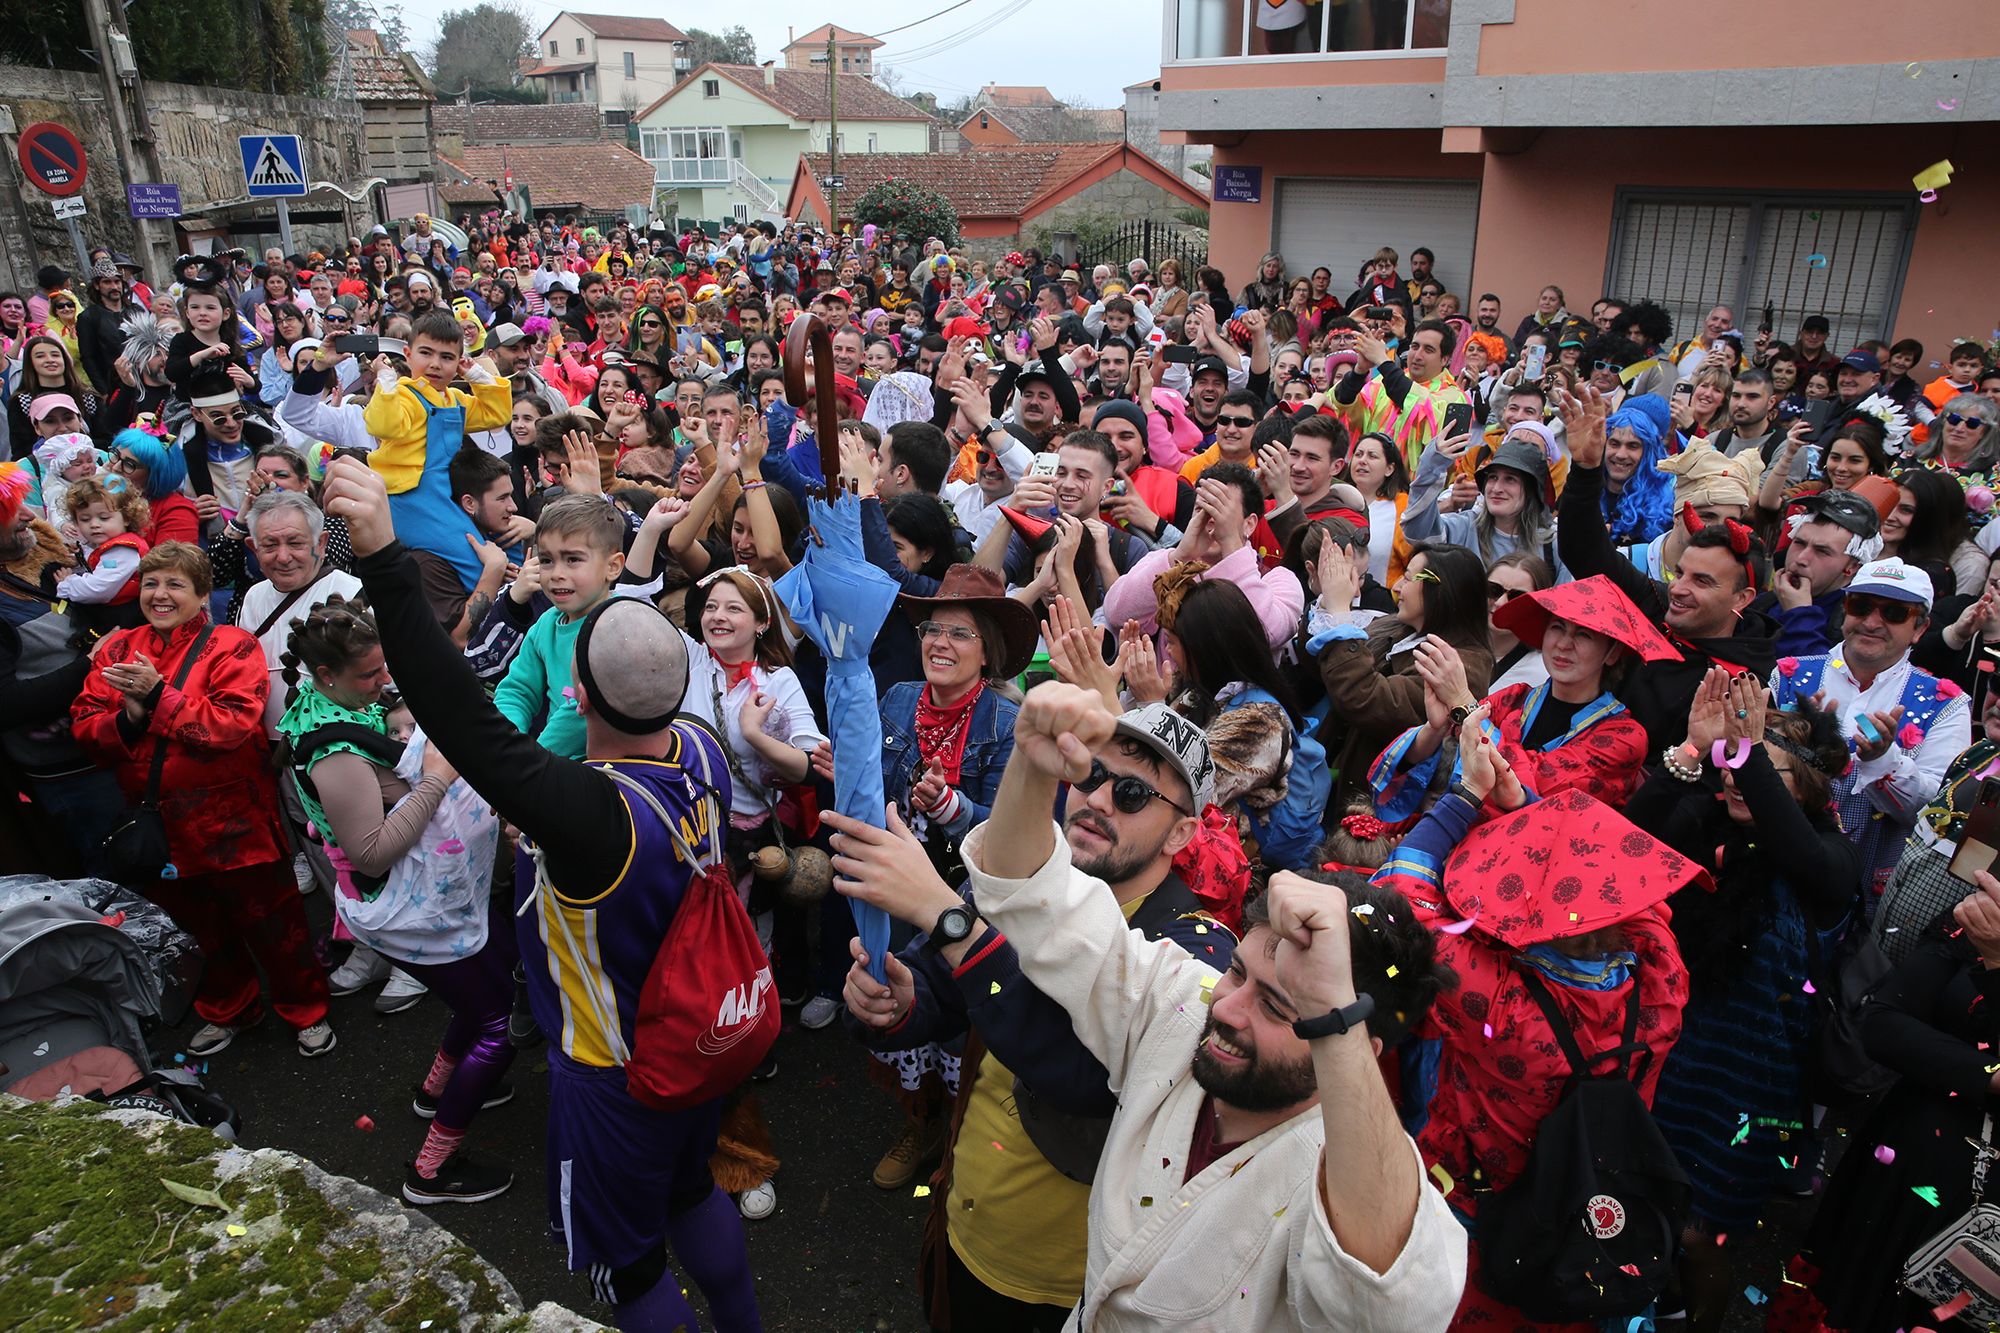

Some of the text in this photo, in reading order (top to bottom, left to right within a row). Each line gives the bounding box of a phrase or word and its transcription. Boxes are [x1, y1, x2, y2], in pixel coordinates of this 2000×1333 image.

[53, 168, 67, 176] ZONA
[145, 186, 161, 195] Rúa
[132, 196, 156, 204] Baixada
[138, 204, 174, 215] de Nerga
